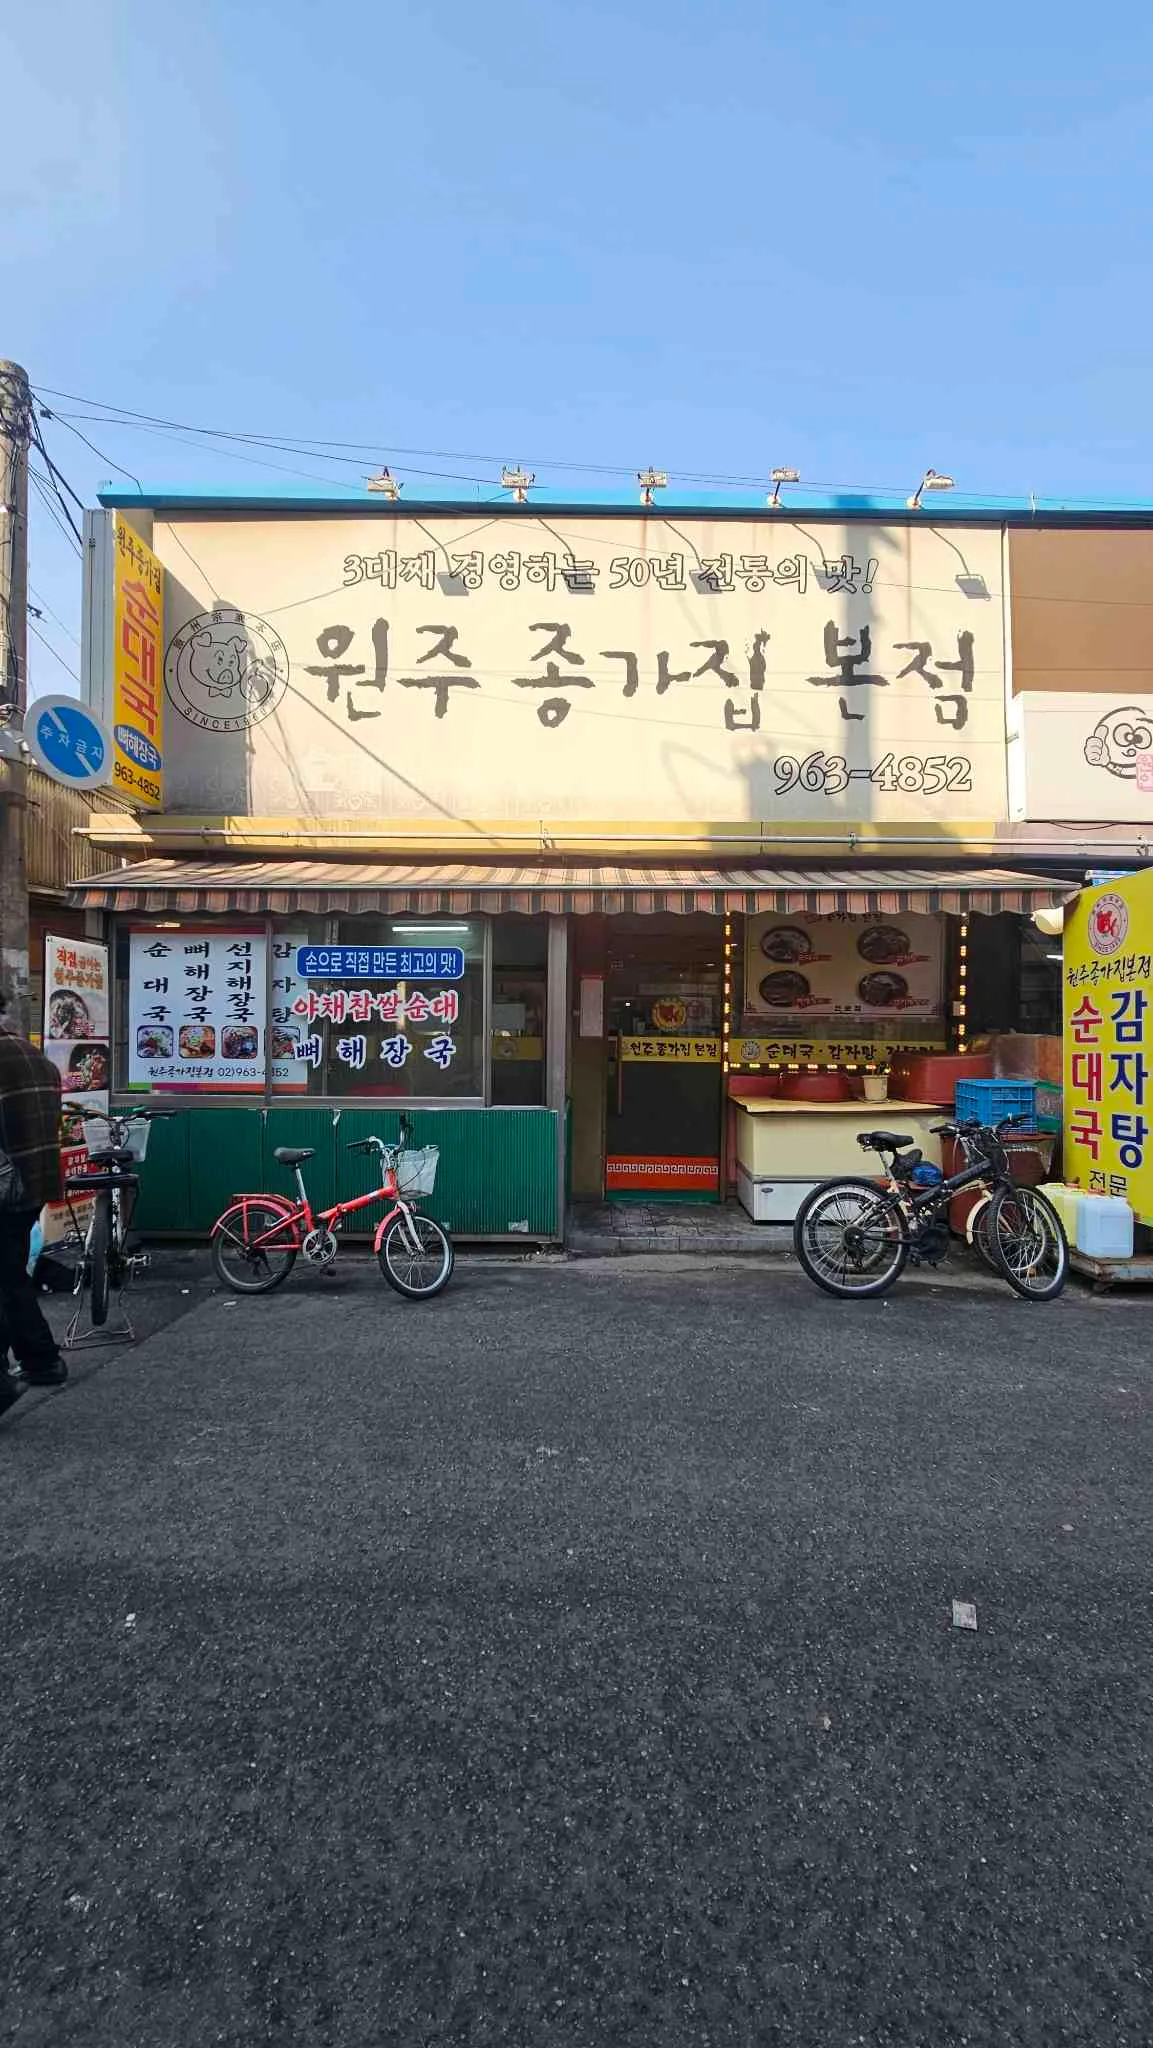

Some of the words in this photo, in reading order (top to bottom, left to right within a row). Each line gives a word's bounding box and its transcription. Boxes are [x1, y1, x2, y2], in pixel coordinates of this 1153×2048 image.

[343, 550, 435, 590] 3대째
[449, 551, 599, 592] 경영하는
[609, 553, 686, 591] 50년
[700, 553, 808, 593] 전통의
[823, 555, 879, 594] 맛!
[120, 578, 158, 736] 순대국
[304, 617, 481, 722] 원주
[511, 622, 771, 732] 종가집
[805, 620, 975, 730] 본점
[114, 761, 160, 801] 963-4852
[774, 750, 973, 795] 963-4852
[143, 942, 172, 1023] 순대국
[183, 941, 213, 1023] 뼈해장국
[225, 941, 256, 1023] 선지해장국
[305, 952, 342, 973] 손으로
[345, 952, 369, 973] 직접
[373, 952, 397, 973] 만든
[400, 952, 437, 973] 최고의
[440, 952, 457, 974] 맛!
[1066, 953, 1151, 987] 원주종가집본점
[293, 990, 458, 1022] 야채찹쌀순대
[296, 1036, 457, 1066] 뼈해장국
[630, 1042, 653, 1057] 원주
[656, 1042, 691, 1057] 종가집
[694, 1042, 717, 1057] 본점
[765, 1043, 815, 1060] 순대국
[218, 1067, 289, 1078] 02)963-52
[1071, 995, 1103, 1161] 순대국
[1110, 990, 1149, 1169] 감자탕
[1089, 1170, 1129, 1199] 전문
